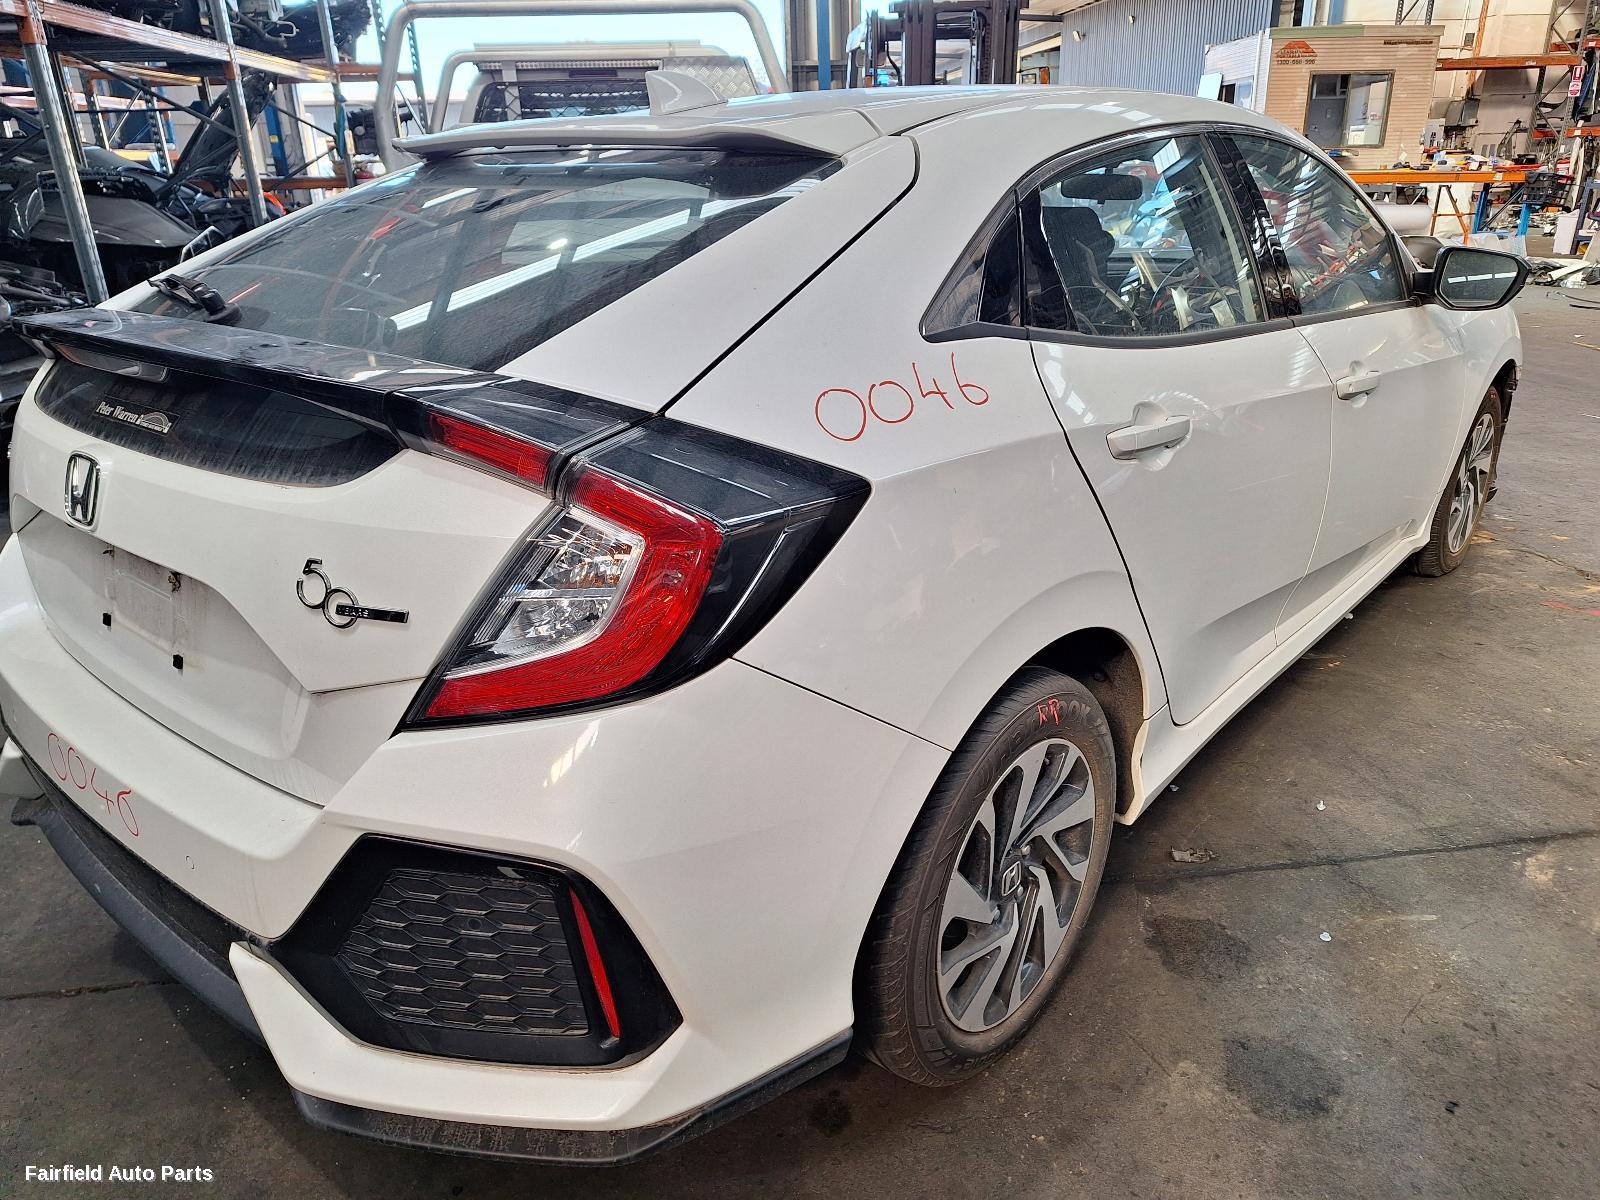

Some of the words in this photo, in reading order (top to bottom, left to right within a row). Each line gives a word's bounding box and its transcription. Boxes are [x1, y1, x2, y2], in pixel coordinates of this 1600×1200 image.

[96, 401, 114, 416] Peter
[112, 405, 139, 424] Warren
[815, 351, 989, 441] 0046
[47, 732, 139, 837] 0046
